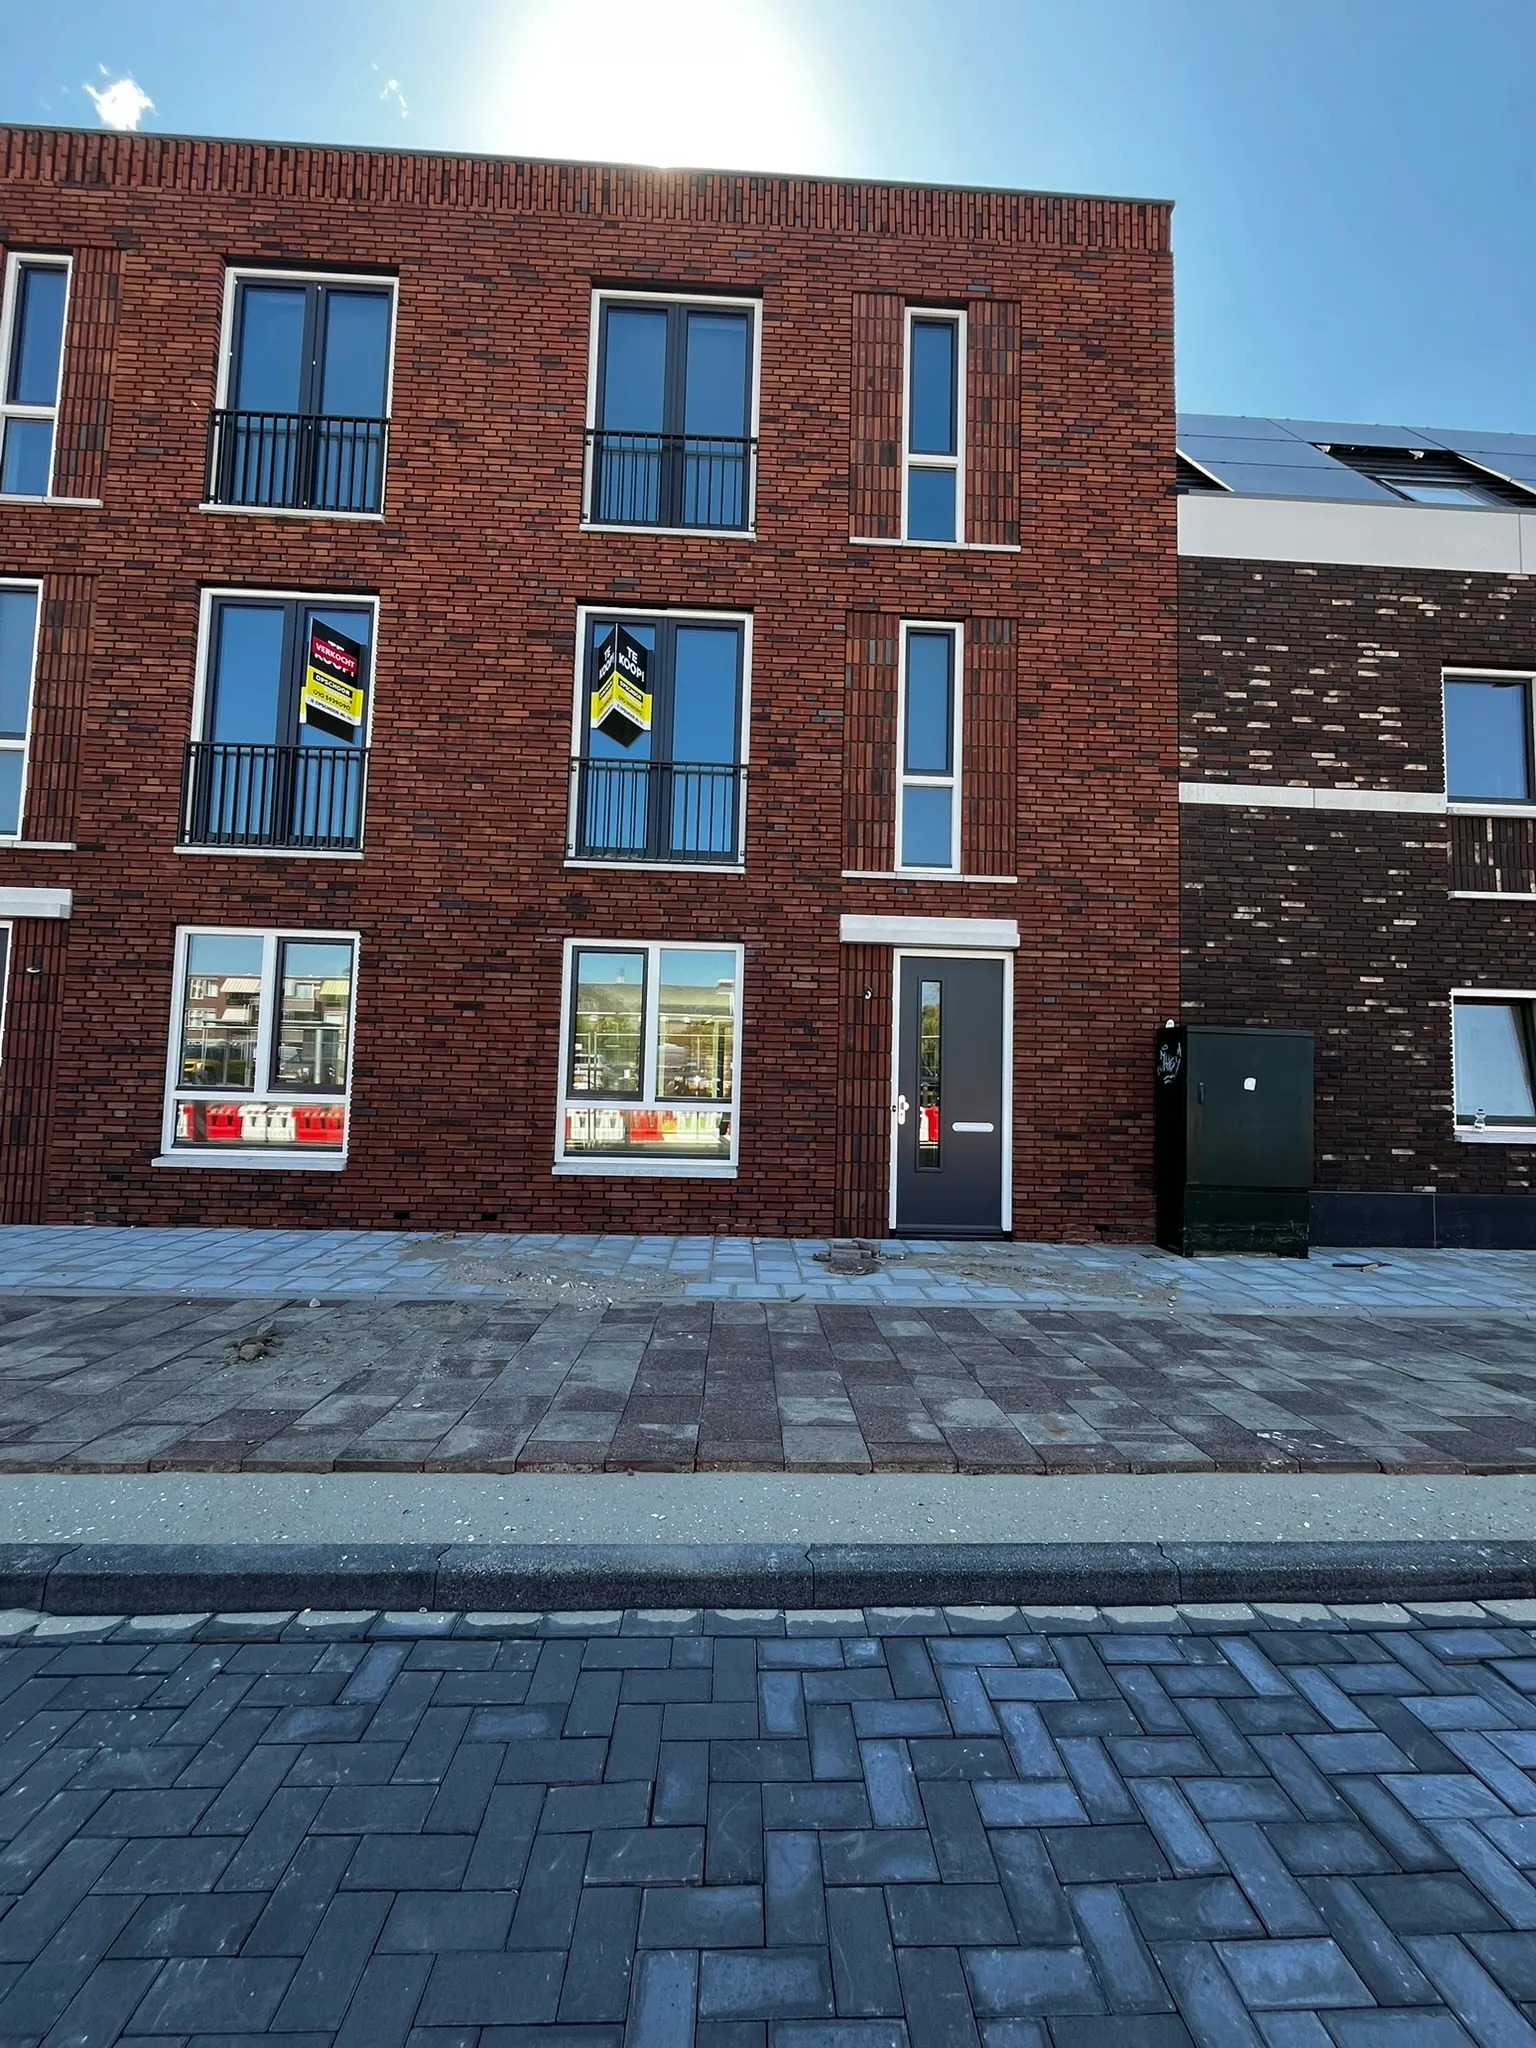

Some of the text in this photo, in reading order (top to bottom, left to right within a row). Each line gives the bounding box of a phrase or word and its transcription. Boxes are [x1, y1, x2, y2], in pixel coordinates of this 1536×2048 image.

[316, 642, 355, 668] VERKOCHT
[618, 652, 644, 682] KOOP!
[626, 646, 638, 664] TE
